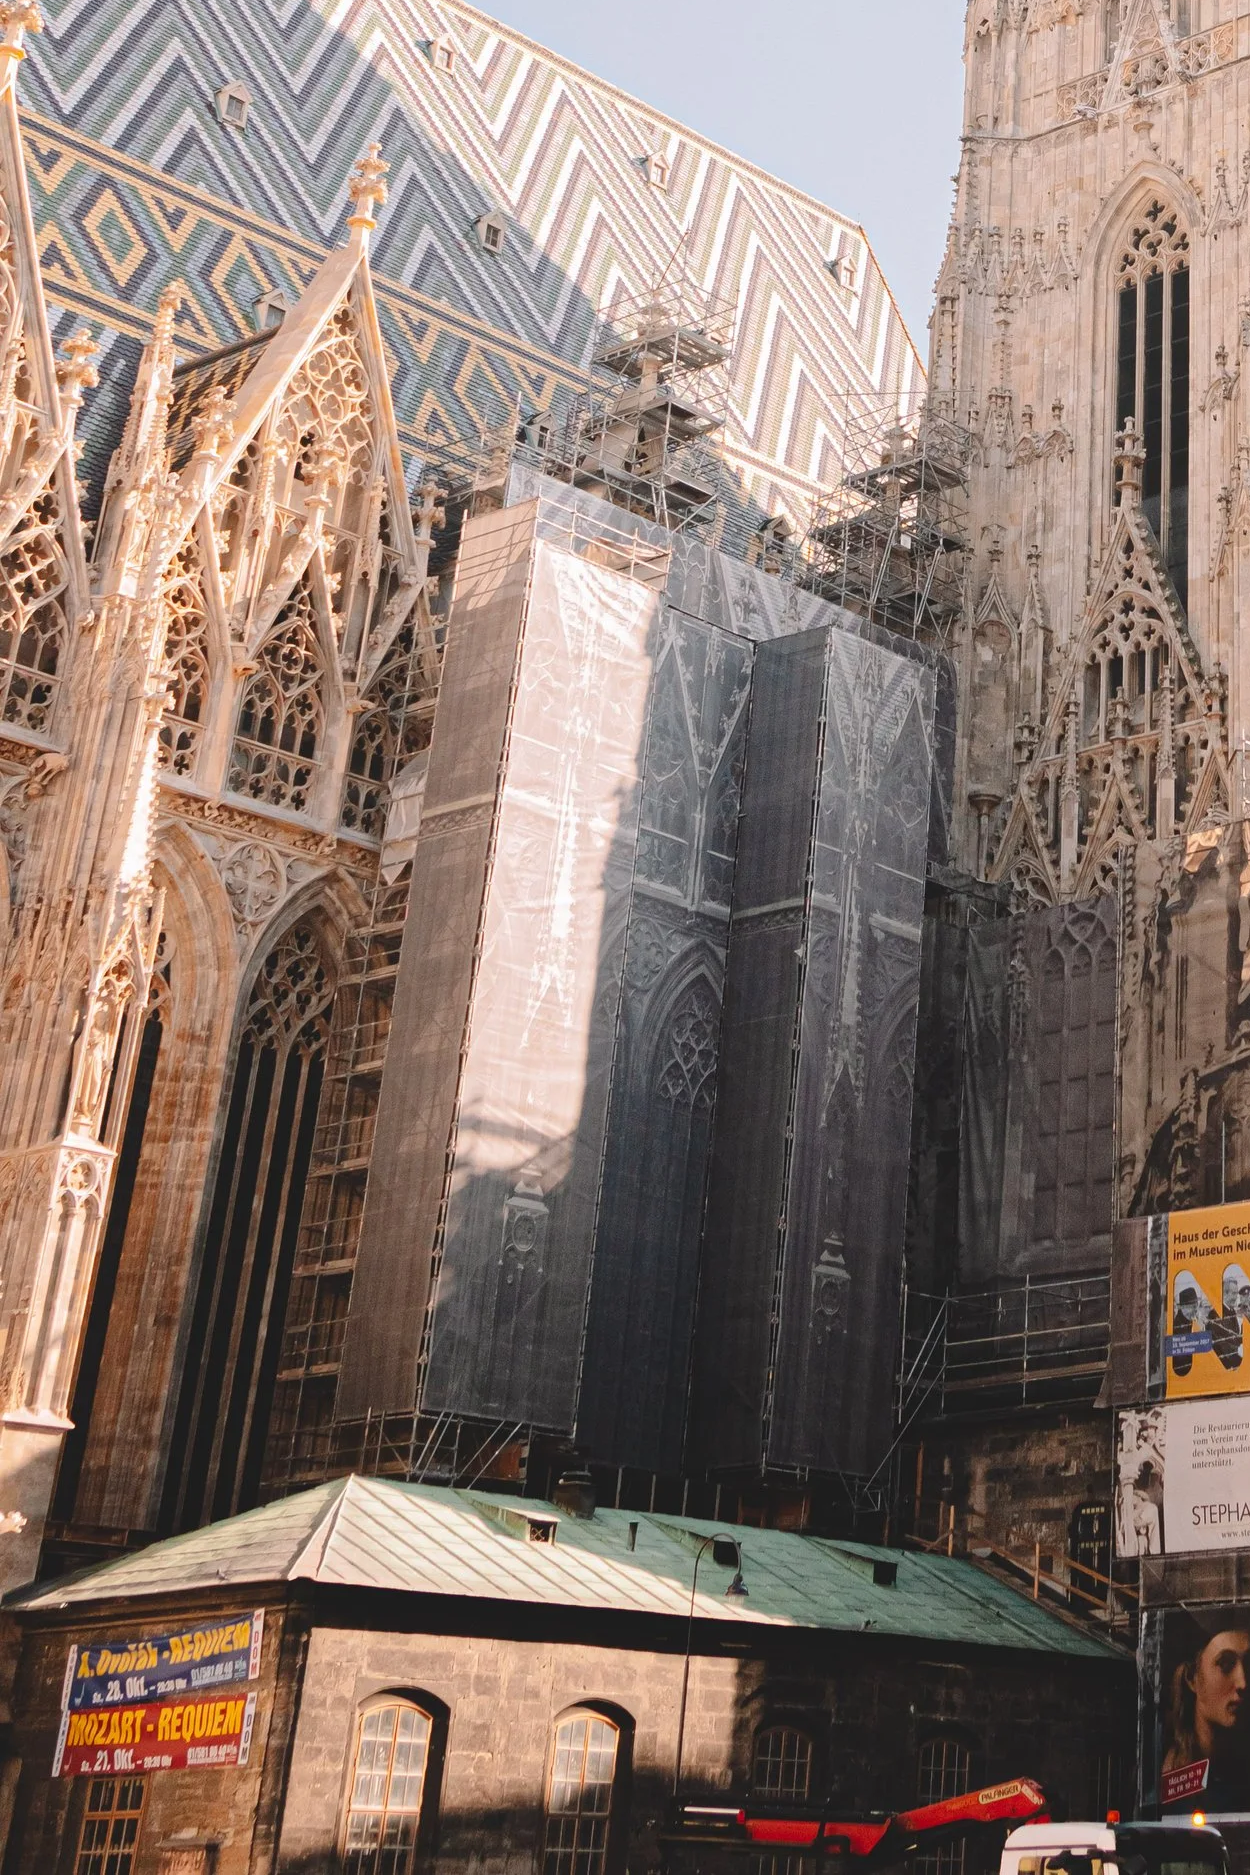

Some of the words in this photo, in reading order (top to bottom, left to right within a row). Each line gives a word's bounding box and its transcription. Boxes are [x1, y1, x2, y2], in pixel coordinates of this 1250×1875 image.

[1173, 1232, 1199, 1244] Haus
[1202, 1228, 1219, 1241] der
[1173, 1249, 1186, 1260] im
[1189, 1244, 1233, 1258] Museum
[1193, 1425, 1206, 1435] Die
[1193, 1437, 1208, 1446] vom
[1210, 1434, 1233, 1444] Verein
[1235, 1433, 1247, 1441] zur
[1192, 1448, 1204, 1458] des
[1192, 1458, 1234, 1469] unterstützt.
[67, 1709, 146, 1747] MOZART
[157, 1700, 245, 1743] REQUIEM
[981, 1784, 1019, 1803] PALFINGER
